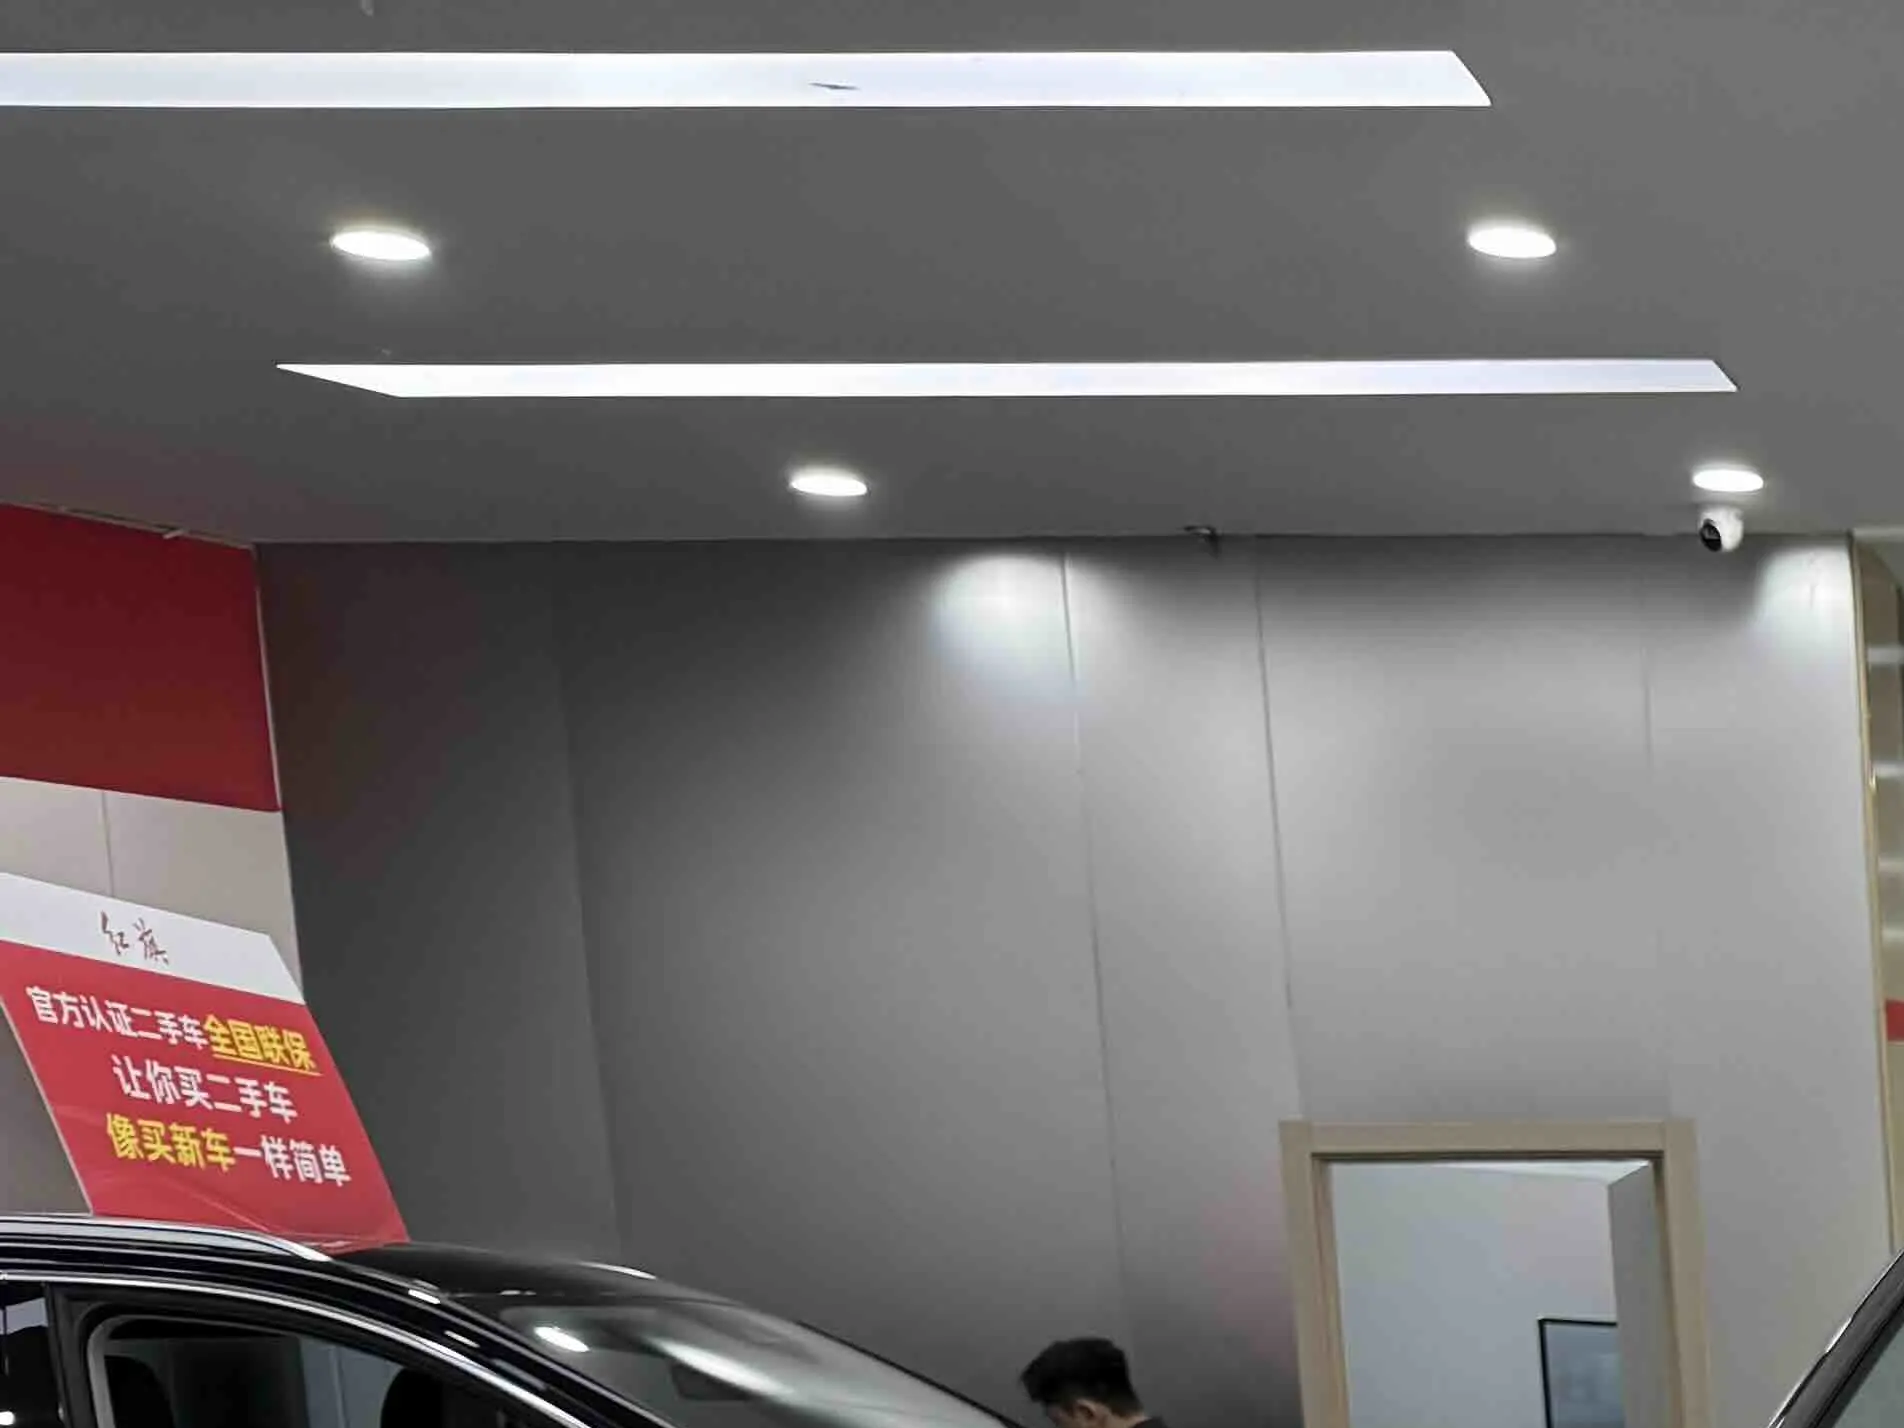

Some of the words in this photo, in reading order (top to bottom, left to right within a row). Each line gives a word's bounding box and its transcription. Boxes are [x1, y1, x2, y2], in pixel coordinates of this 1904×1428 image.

[100, 911, 169, 965] 红旗
[26, 985, 318, 1071] 官方认证二手车全国联保
[111, 1054, 298, 1124] 让你买二手车
[106, 1112, 352, 1187] 像买新车一样简单
